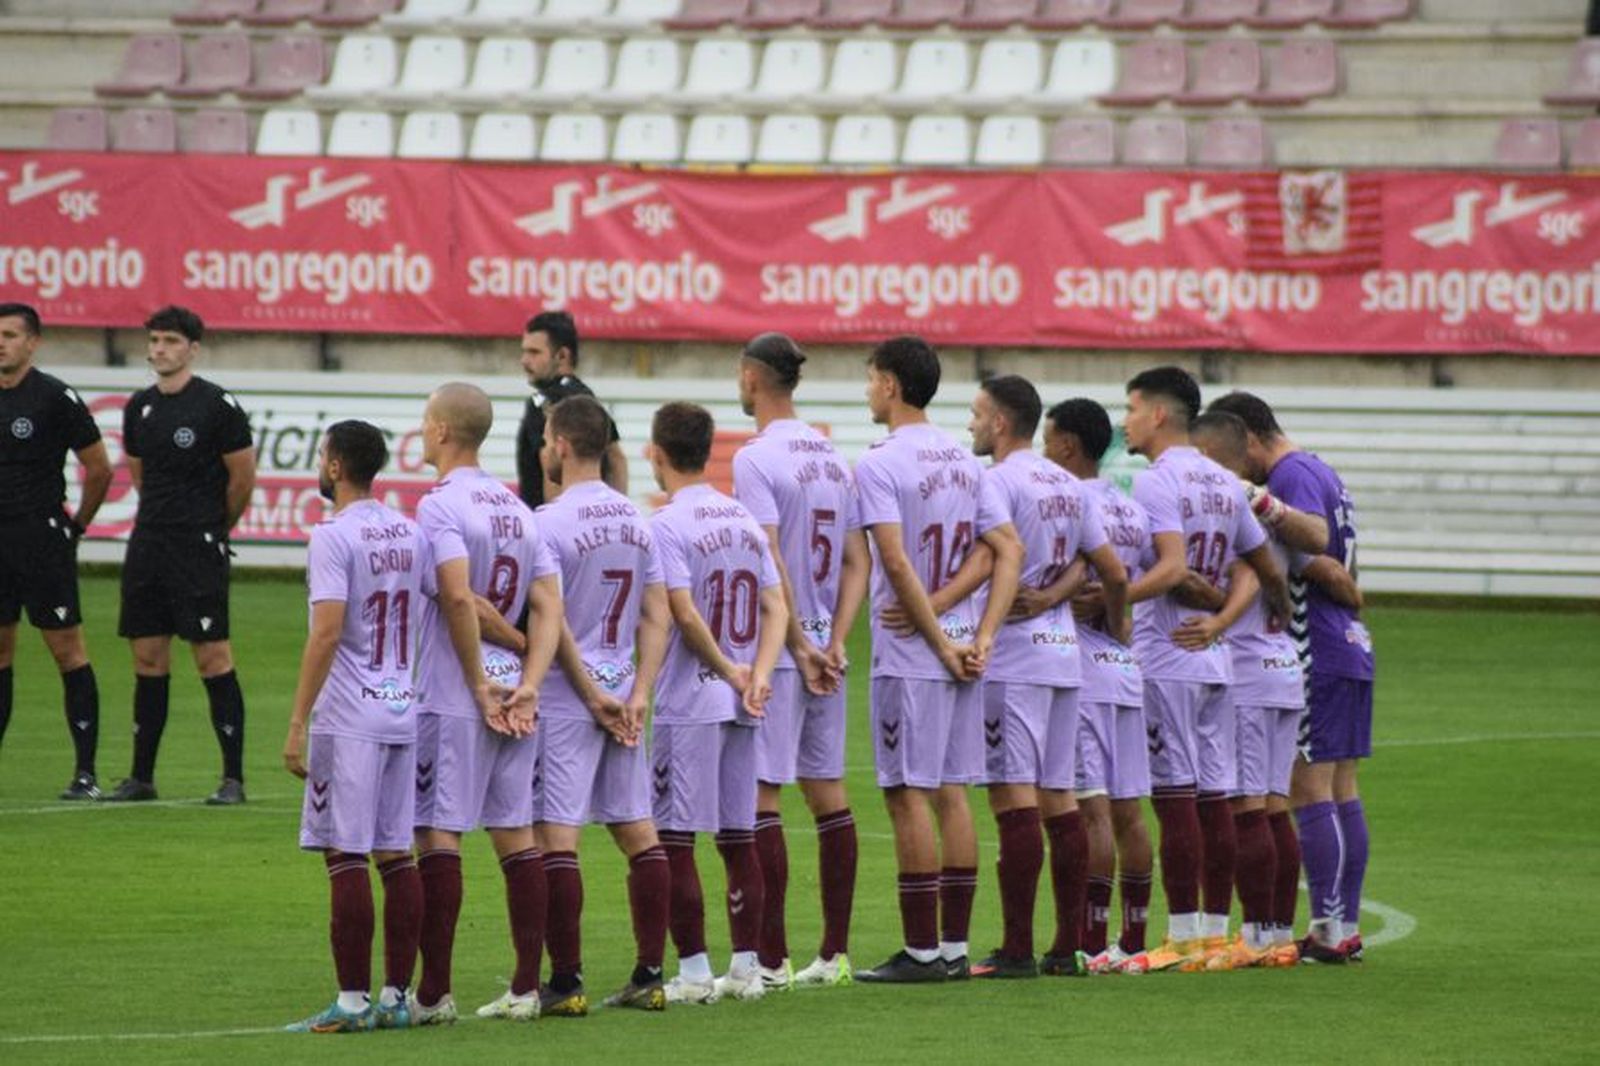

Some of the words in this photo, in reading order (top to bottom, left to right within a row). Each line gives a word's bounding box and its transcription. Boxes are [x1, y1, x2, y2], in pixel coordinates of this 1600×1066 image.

[58, 190, 99, 222] sgc
[345, 195, 387, 227] sgc
[632, 203, 675, 235] sgc
[927, 204, 970, 239] sgc
[1537, 210, 1584, 247] sgc
[183, 243, 433, 304] sangregorio
[467, 252, 722, 314] sangregorio
[760, 255, 1021, 318] sangregorio
[1053, 267, 1320, 322] sangregorio
[574, 524, 611, 557] ALEX
[811, 508, 836, 584] 5
[361, 588, 411, 672] 11
[601, 569, 633, 650] 7
[703, 569, 760, 650] 10
